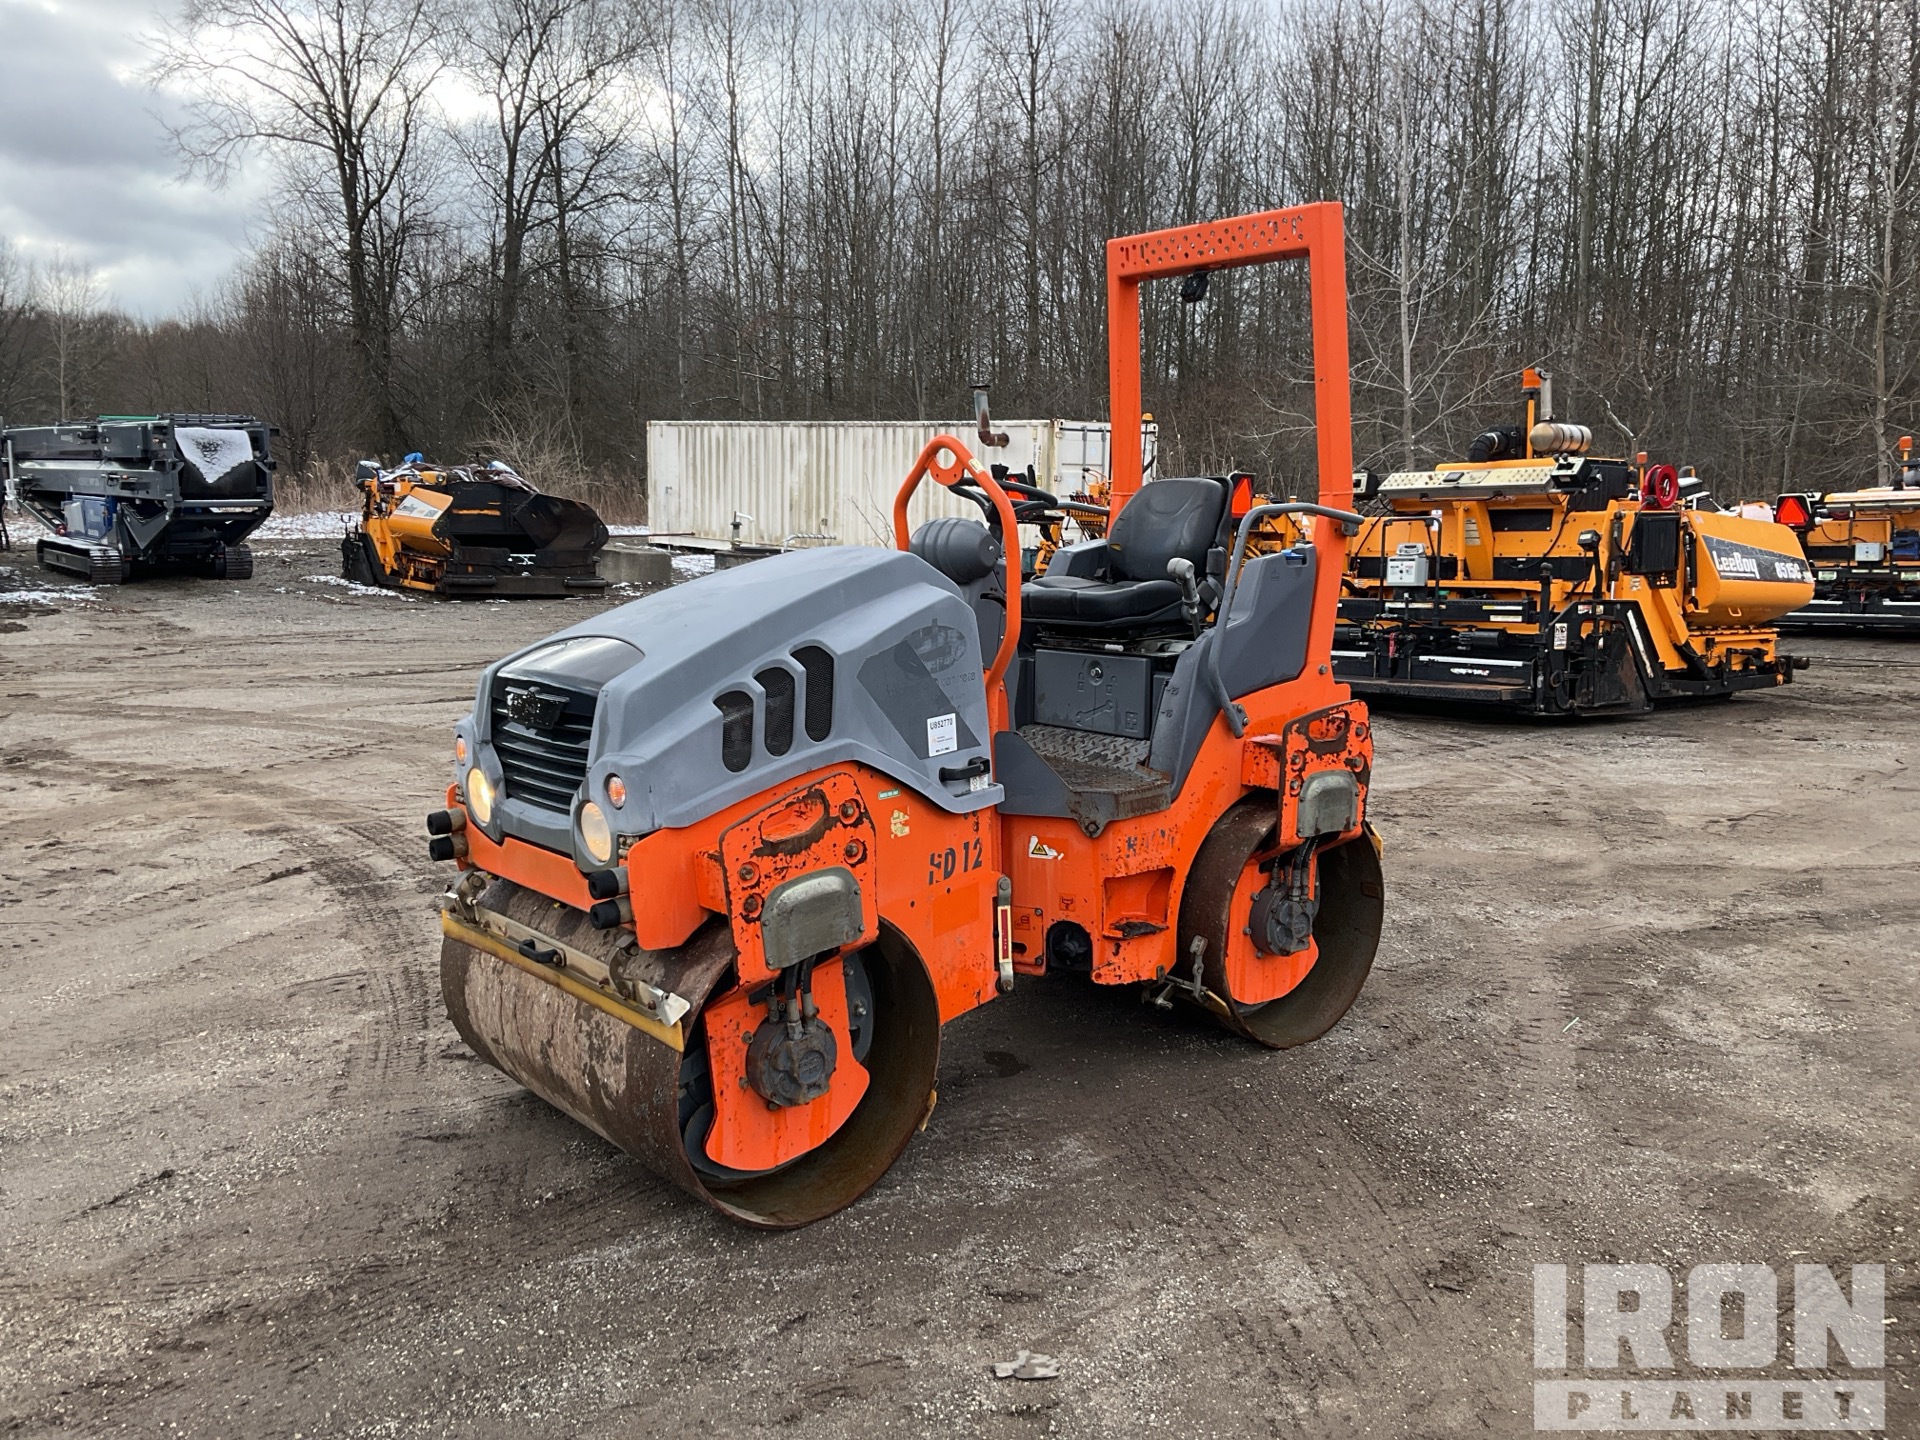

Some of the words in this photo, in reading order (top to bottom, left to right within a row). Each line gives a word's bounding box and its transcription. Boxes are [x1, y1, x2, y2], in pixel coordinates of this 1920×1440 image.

[1712, 551, 1760, 579] LeeBoy
[930, 718, 953, 730] U852770
[963, 837, 983, 873] 12
